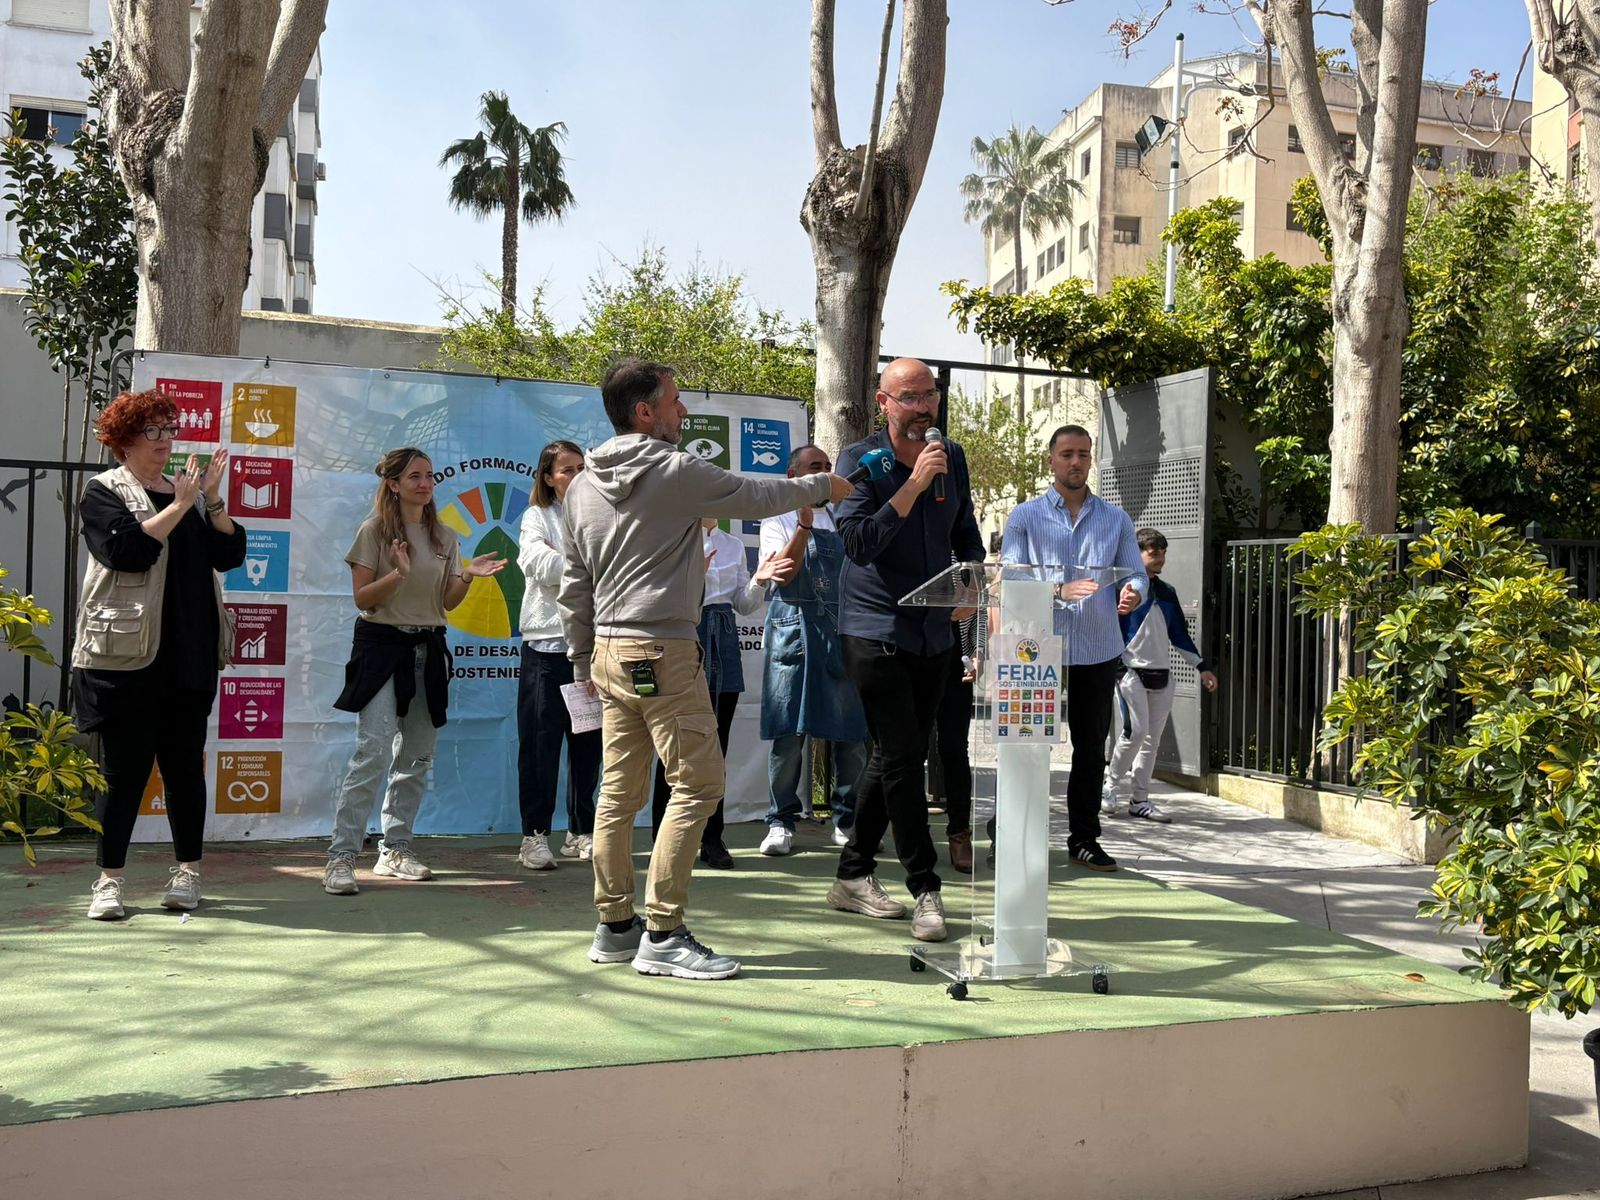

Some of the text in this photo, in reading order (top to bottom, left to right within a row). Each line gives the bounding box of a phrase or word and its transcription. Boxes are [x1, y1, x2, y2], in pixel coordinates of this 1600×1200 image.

[237, 387, 245, 401] 2
[743, 421, 755, 434] 14
[233, 460, 242, 473] 4
[245, 460, 272, 469] EDUCACIÓN
[433, 467, 456, 486] DO
[238, 607, 258, 615] TRABAJO
[736, 626, 764, 637] ESAS
[454, 646, 520, 657] DE DESA
[738, 641, 762, 651] ADO
[997, 664, 1058, 681] FERIA
[223, 681, 236, 696] 10
[239, 681, 266, 689] REDUCCIÓN
[220, 756, 234, 770] 12
